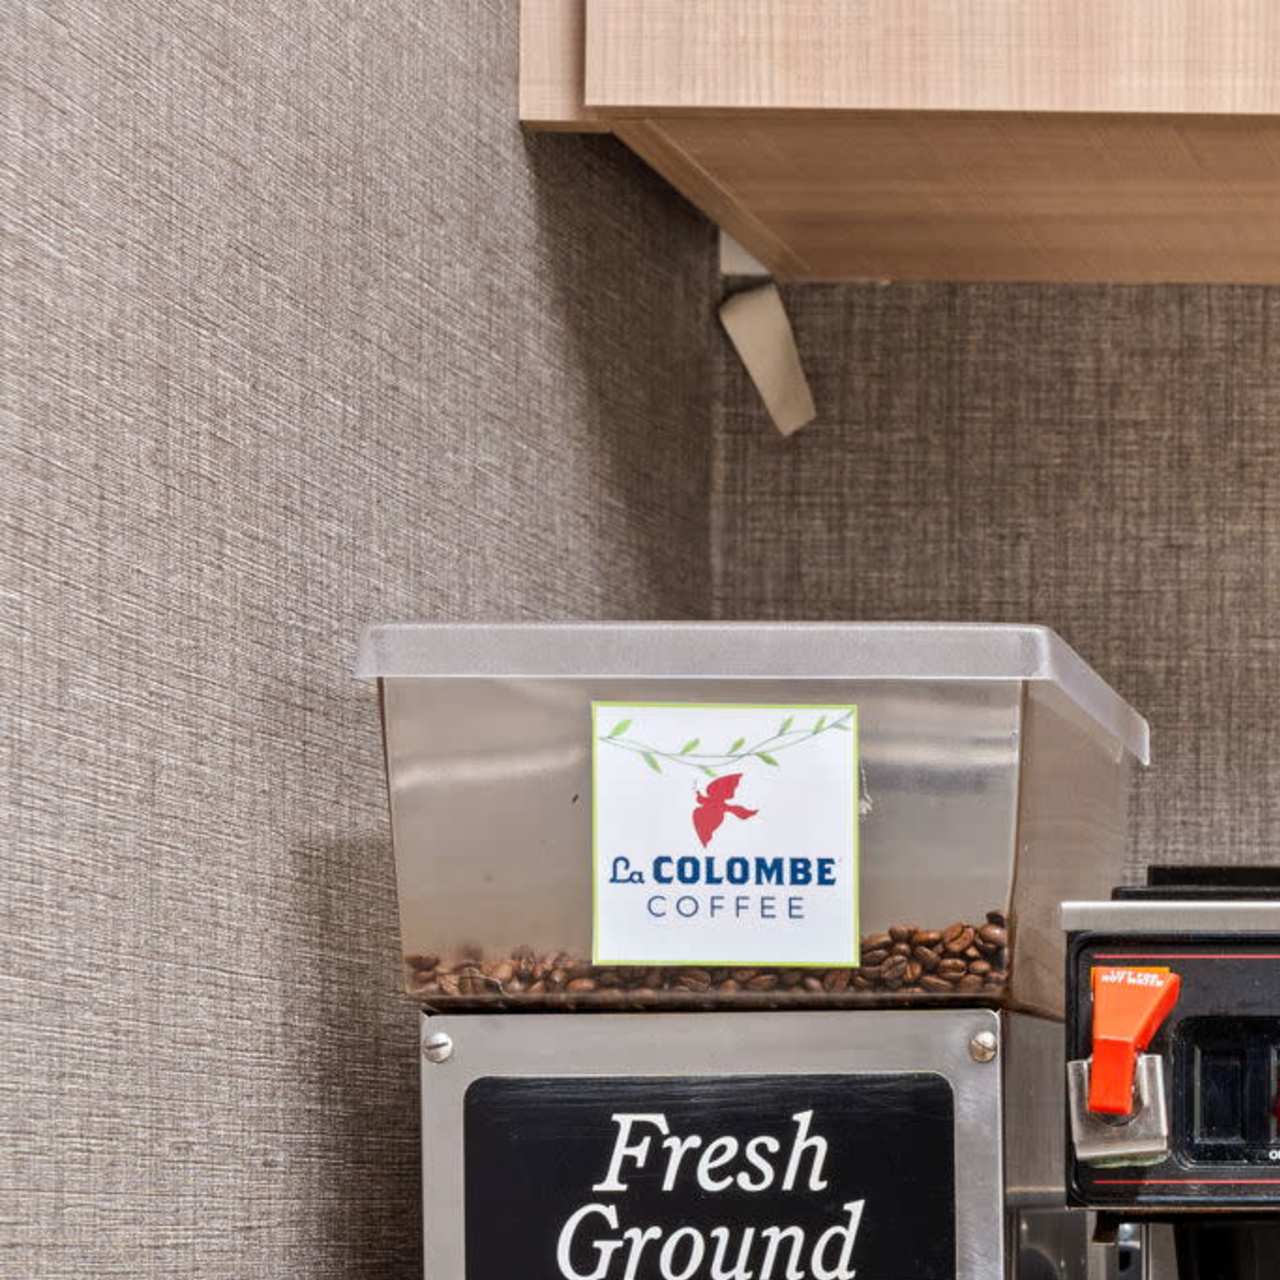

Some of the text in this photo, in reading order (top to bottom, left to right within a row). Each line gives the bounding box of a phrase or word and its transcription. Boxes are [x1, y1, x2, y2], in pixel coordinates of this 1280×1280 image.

[609, 855, 837, 886] La COLOMBE
[647, 895, 805, 919] COFFEE
[592, 1109, 828, 1193] Fresh
